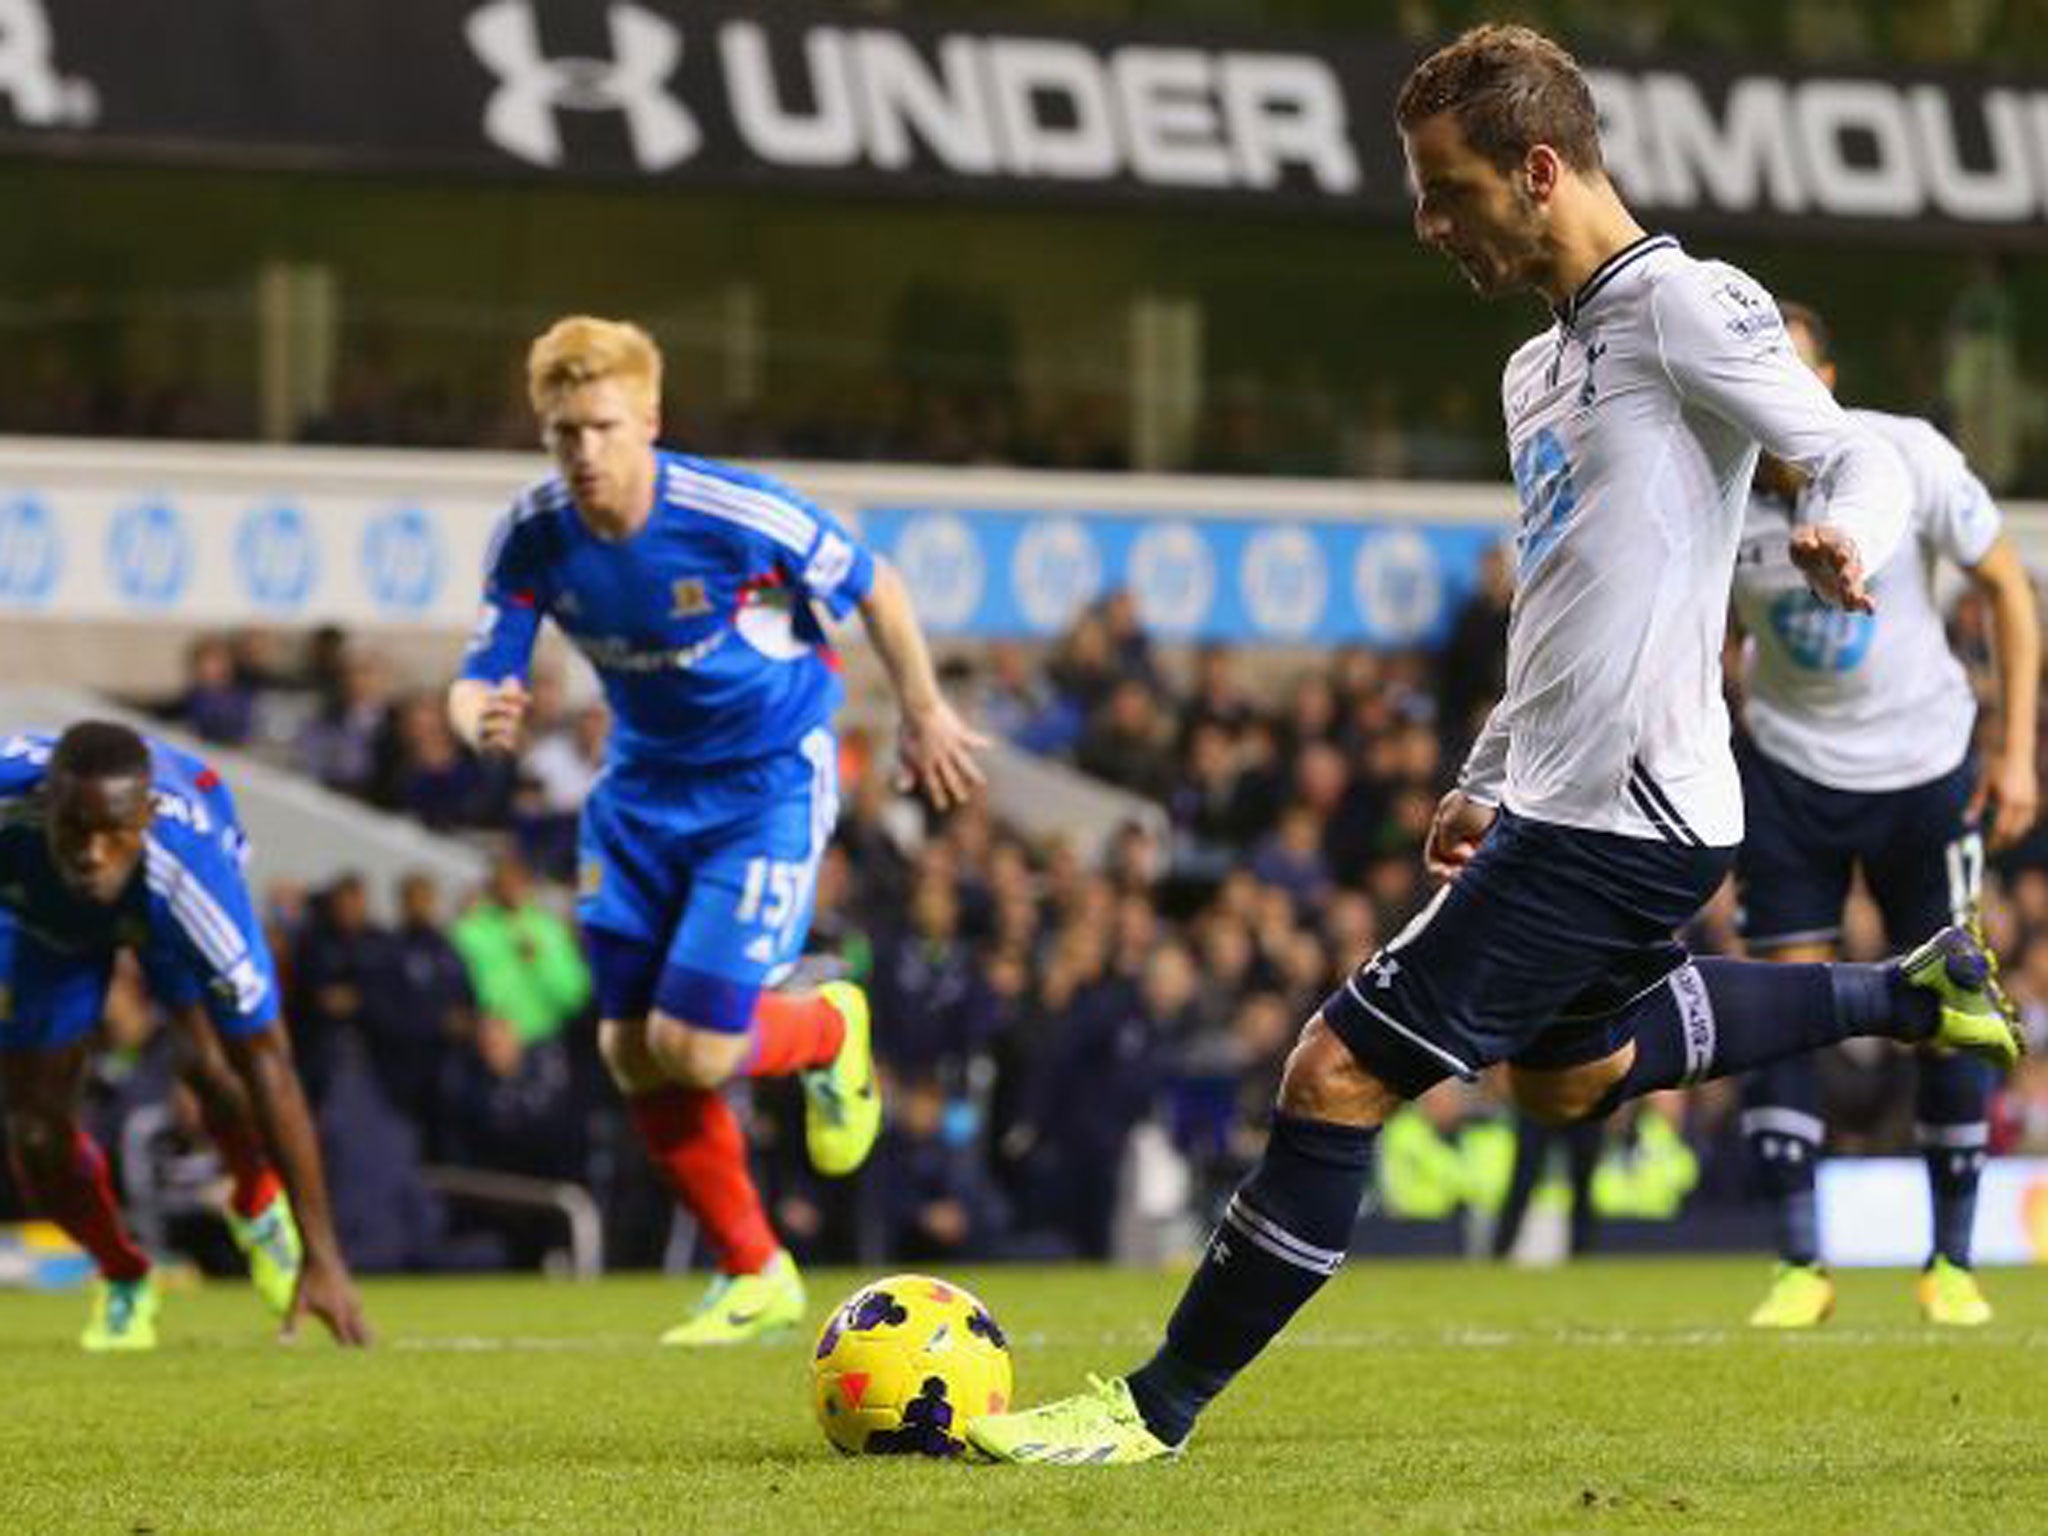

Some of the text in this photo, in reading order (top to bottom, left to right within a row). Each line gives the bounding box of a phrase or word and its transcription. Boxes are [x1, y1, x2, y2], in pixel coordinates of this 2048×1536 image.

[719, 20, 2048, 222] UNDER RMOU
[734, 856, 795, 928] 15
[1946, 832, 1985, 927] 17
